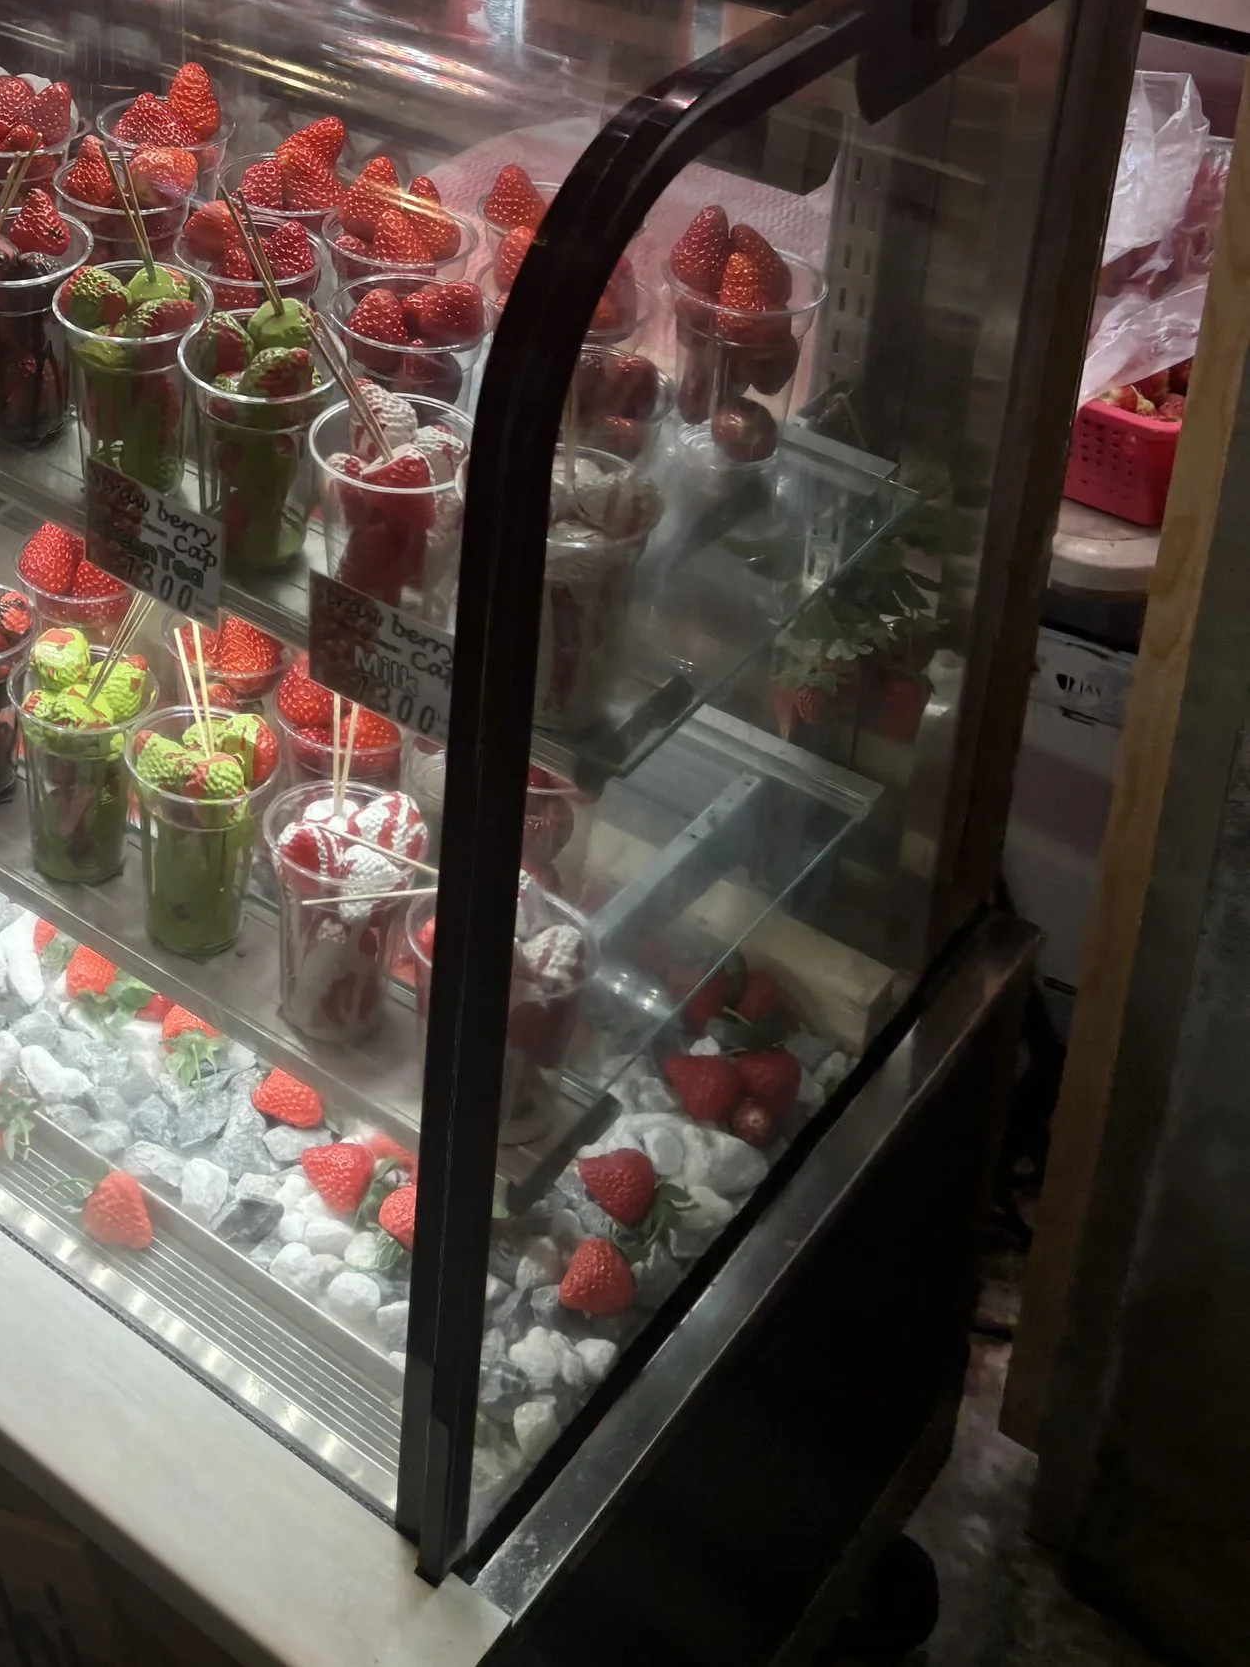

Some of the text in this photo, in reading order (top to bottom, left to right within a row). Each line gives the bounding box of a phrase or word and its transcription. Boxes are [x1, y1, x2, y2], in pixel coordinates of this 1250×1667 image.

[172, 534, 219, 573] Cap
[124, 553, 194, 613] 1300
[353, 644, 419, 698] Milk
